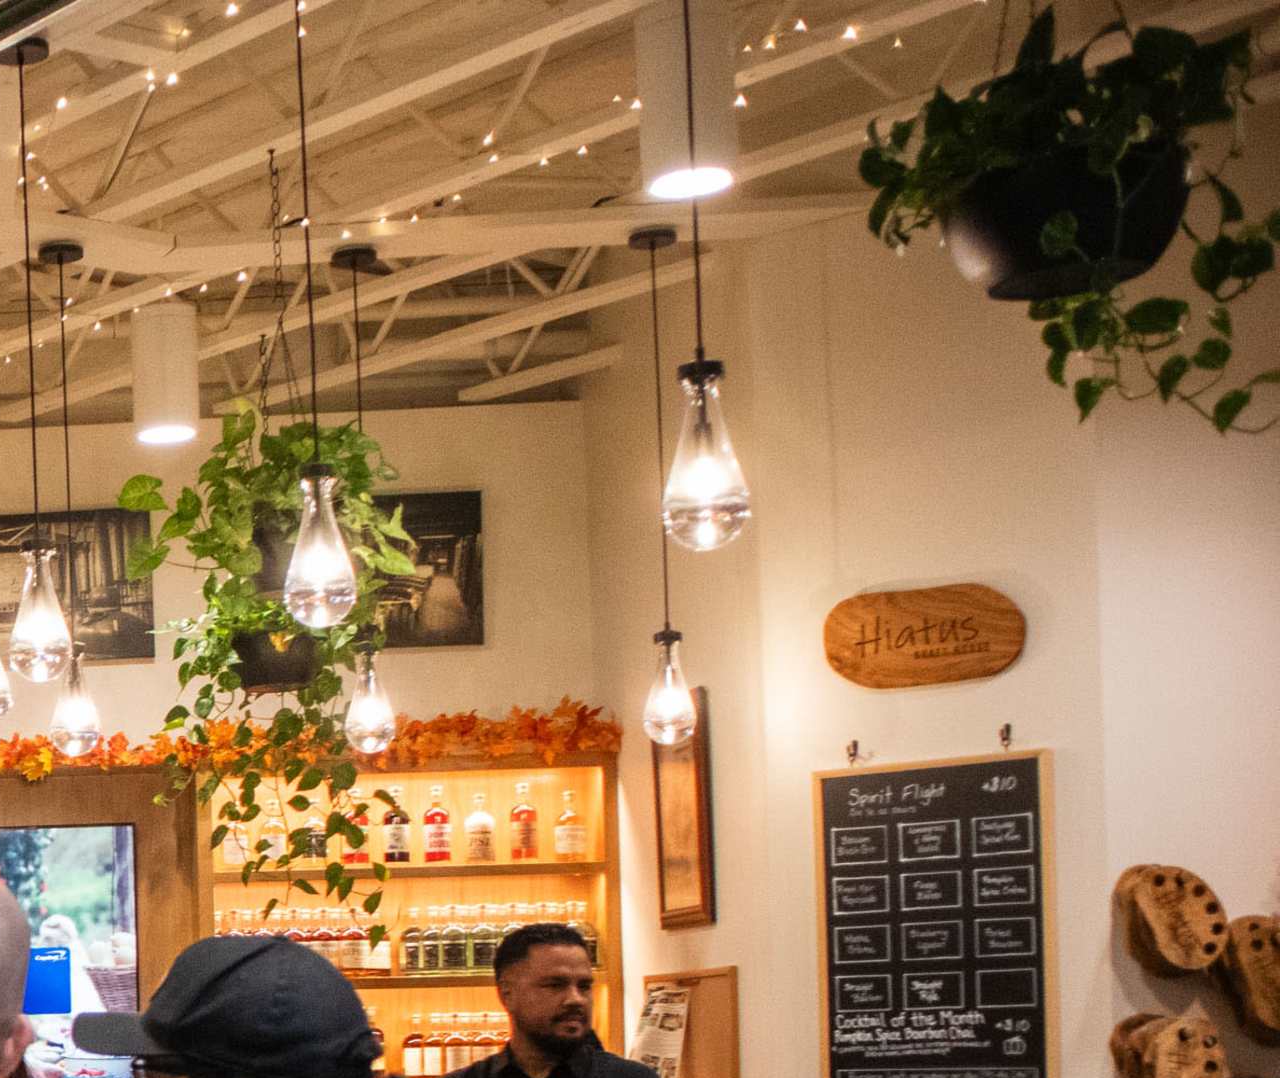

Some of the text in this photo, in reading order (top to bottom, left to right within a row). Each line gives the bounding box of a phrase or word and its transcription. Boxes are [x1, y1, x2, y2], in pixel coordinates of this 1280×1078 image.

[854, 615, 980, 658] Hiatus
[848, 786, 893, 807] Spirit
[902, 783, 945, 806] Flight
[835, 1013, 887, 1029] Cocktail
[891, 1012, 907, 1027] of
[910, 1012, 938, 1027] the
[940, 1010, 986, 1026] Month
[834, 1029, 873, 1044] Pumpkin
[875, 1028, 902, 1042] Spice
[904, 1026, 947, 1041] Bourbon
